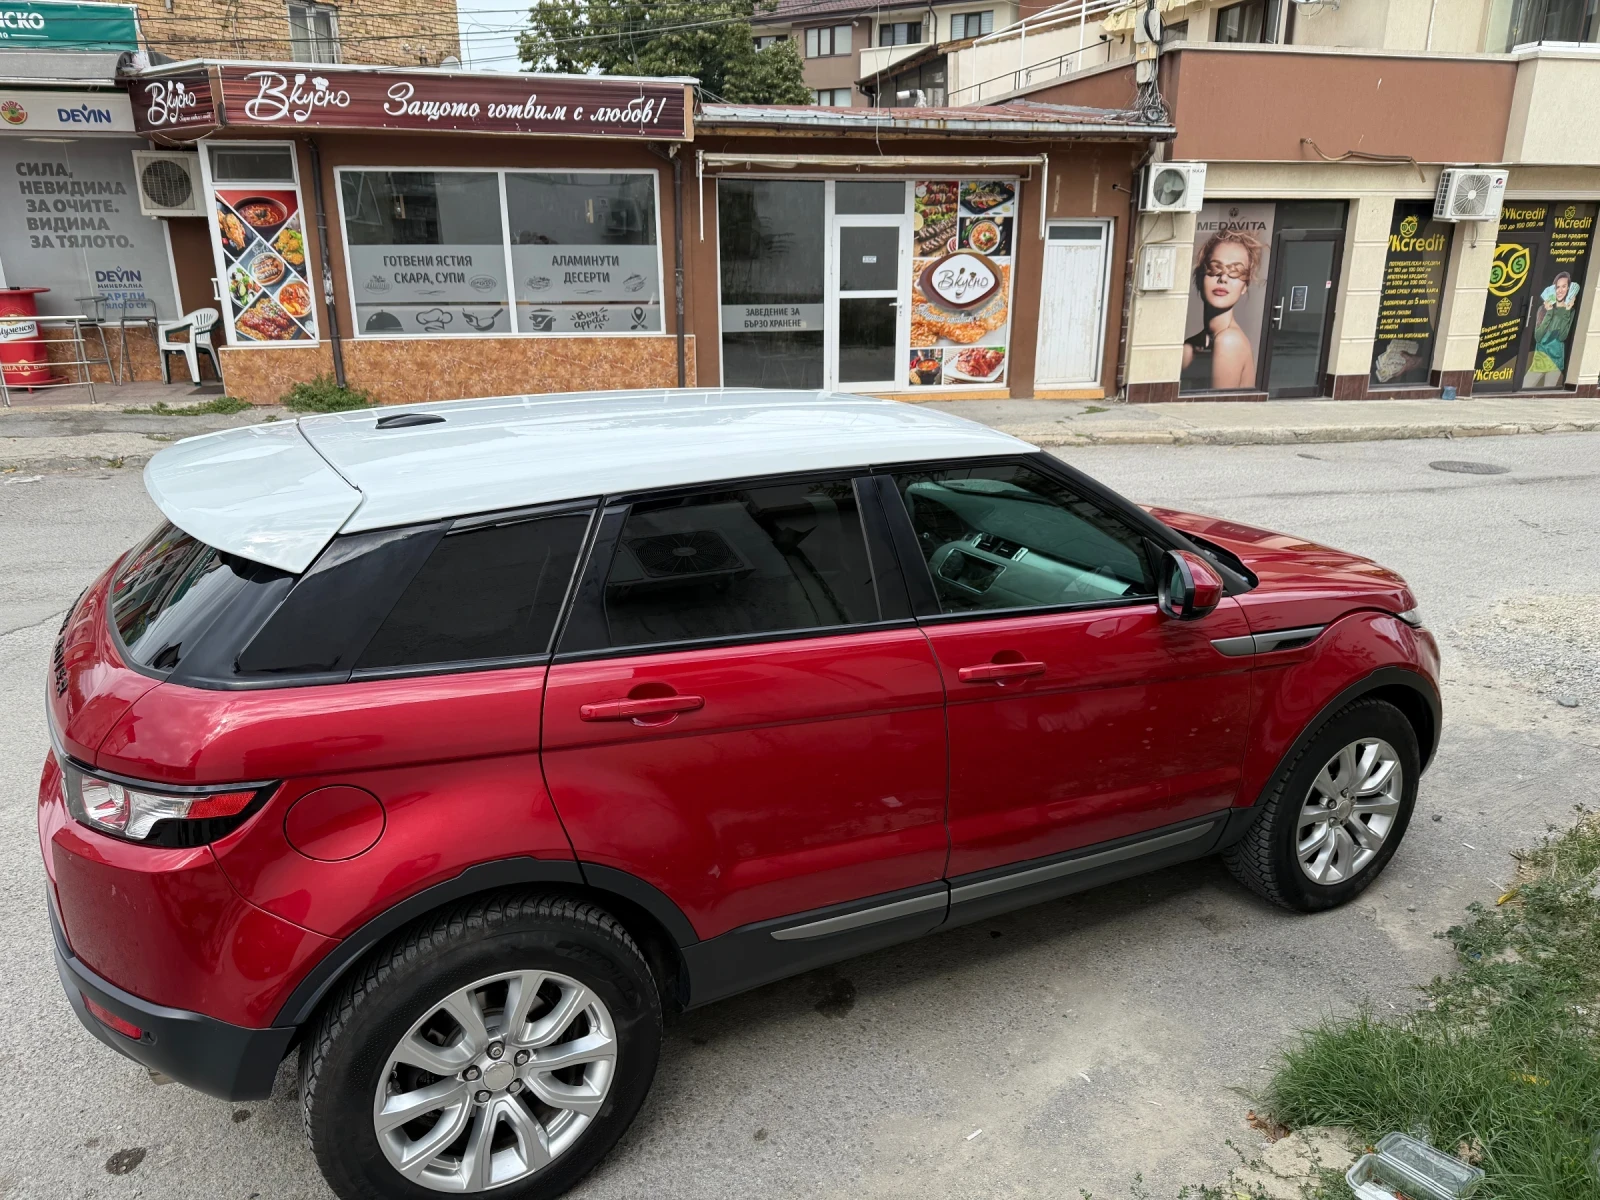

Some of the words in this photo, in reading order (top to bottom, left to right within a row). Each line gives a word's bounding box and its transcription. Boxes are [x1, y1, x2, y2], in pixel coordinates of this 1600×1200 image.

[144, 80, 196, 125] Вкусно
[243, 70, 350, 122] Вкусно
[383, 82, 481, 122] Защото
[487, 94, 566, 121] готвим
[573, 106, 584, 121] с
[589, 95, 667, 124] любов!
[57, 107, 111, 123] DEVIN
[15, 162, 73, 178] СИЛА,
[18, 180, 127, 197] НЕВИДИМА
[26, 199, 51, 212] ЗА
[53, 199, 119, 213] ОЧИТЕ.
[1505, 207, 1545, 220] VKcredit
[26, 217, 111, 233] ВИДИМА
[1196, 221, 1267, 230] MEDAVITA
[1554, 216, 1592, 229] VKcredit
[29, 235, 55, 248] ЗА
[55, 235, 134, 249] ТЯЛОТО.
[383, 255, 433, 267] ГОТВЕНИ
[436, 255, 472, 267] ЯСТИЯ
[552, 255, 620, 267] АЛАМИНУТИ
[95, 270, 142, 282] DEVIN
[394, 272, 434, 285] СКАРА,
[436, 272, 466, 284] СУПИ
[564, 272, 610, 284] ДЕСЕРТИ
[938, 268, 988, 299] Вкусно
[746, 308, 788, 317] ЗАВЕДЕНИЕ
[790, 308, 800, 316] ЗА
[744, 320, 768, 328] БЪРЗО
[770, 319, 802, 328] ХРАНЕНЕ
